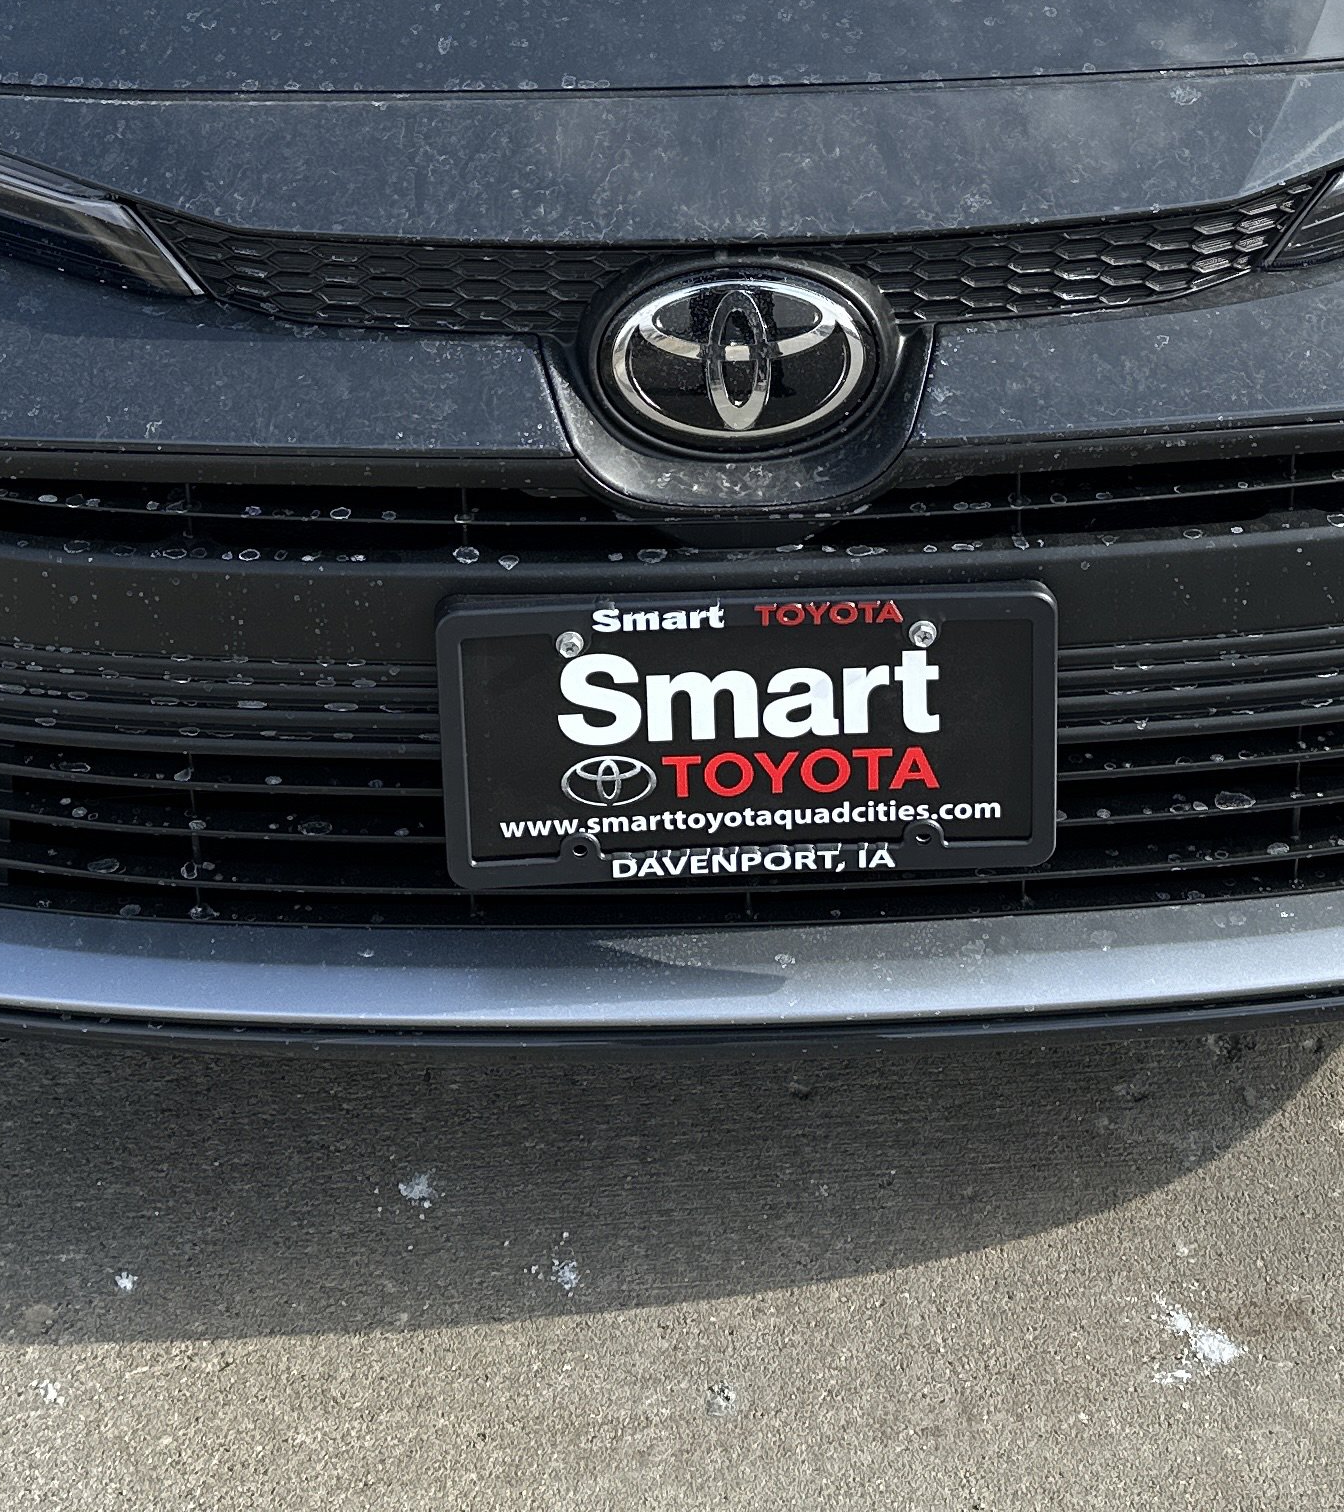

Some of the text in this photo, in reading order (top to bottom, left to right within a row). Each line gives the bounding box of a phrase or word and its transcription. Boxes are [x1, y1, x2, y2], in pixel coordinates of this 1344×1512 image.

[591, 599, 904, 633] Smart TOYOTA
[558, 650, 940, 746] Smart
[662, 747, 941, 798] TOYOTA
[499, 799, 1002, 839] www.smarttoyotaquadcities.com
[611, 848, 896, 878] DAVENPORT, IA
